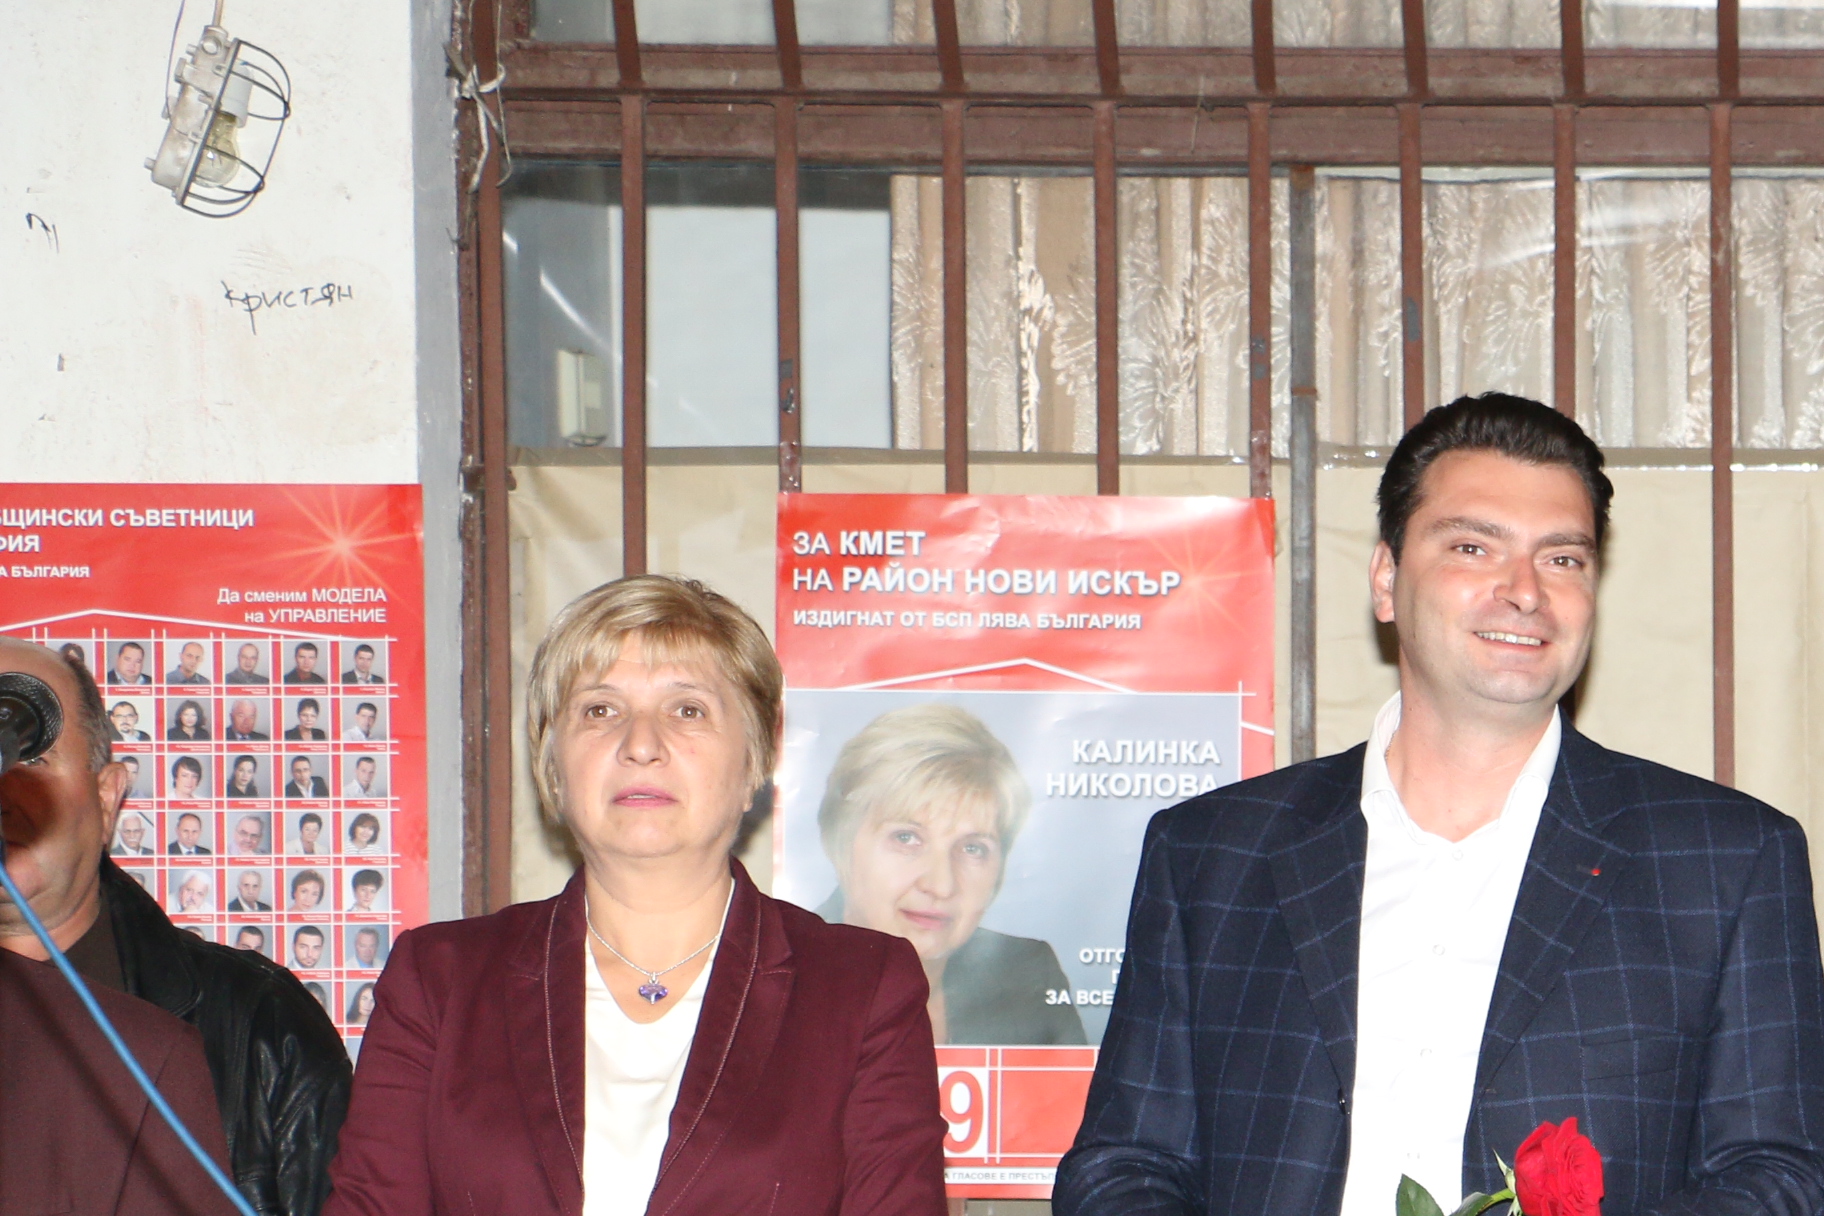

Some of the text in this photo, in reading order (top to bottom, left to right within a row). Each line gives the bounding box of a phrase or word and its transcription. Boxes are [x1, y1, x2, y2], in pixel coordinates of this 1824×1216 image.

[0, 508, 254, 530] ЩИНСКИ СЪВЕТНИЦИ
[793, 531, 926, 556] ЗА КМЕТ
[11, 565, 90, 578] БЪЛГАРИЯ
[793, 561, 1181, 596] НА РАЙОН НОВИ ИСКЪР
[217, 588, 387, 605] Да сменим МОДЕЛА
[244, 609, 387, 623] на УПРАВЛЕНИЕ
[793, 610, 1142, 630] ИЗДИГНАТ ОТ БСП ЛЯВА БЪЛГАРИЯ
[1072, 739, 1221, 765] КАЛИНКА
[1046, 773, 1218, 798] НИКОЛОВА
[1045, 989, 1072, 1005] ЗА
[939, 1070, 984, 1154] 9
[952, 1172, 997, 1180] ГЛАСОВЕ
